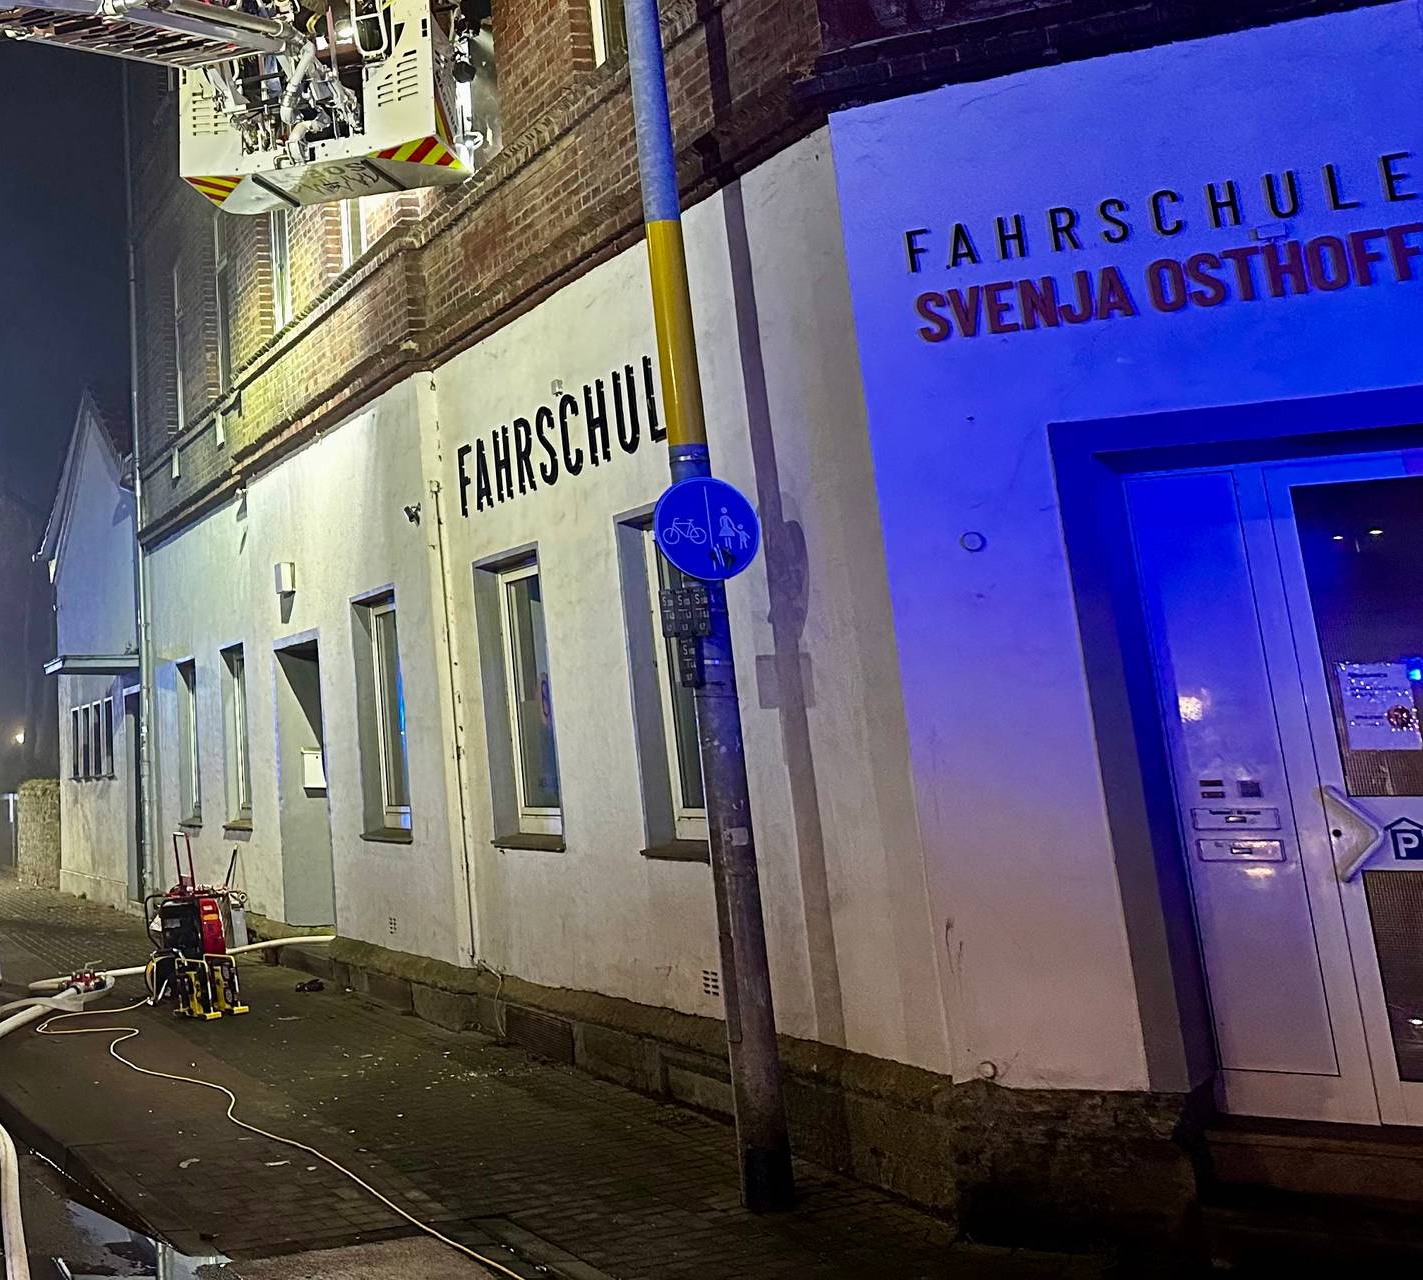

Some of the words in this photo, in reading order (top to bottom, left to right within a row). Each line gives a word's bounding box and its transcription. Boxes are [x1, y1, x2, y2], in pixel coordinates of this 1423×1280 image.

[904, 151, 1419, 273] FAHRSCHULE
[916, 265, 1135, 344] SVENJA
[1147, 223, 1423, 313] OSTHOFF
[457, 355, 667, 518] FAHRSCHUL
